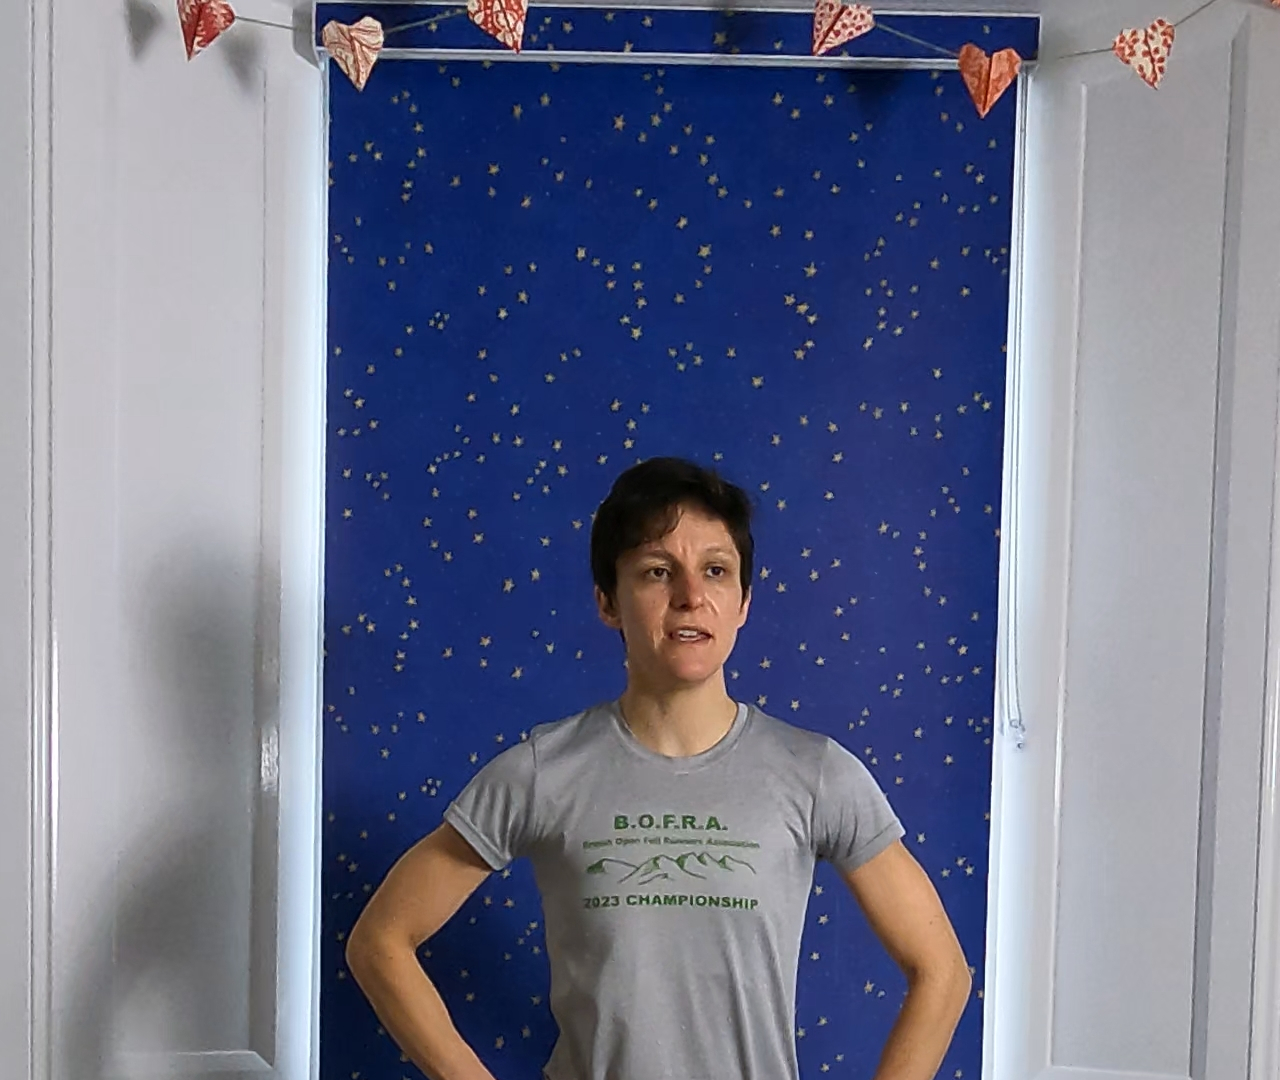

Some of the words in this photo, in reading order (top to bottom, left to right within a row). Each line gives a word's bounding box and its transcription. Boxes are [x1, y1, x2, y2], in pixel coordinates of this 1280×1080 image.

[614, 814, 728, 830] B.O.F.R.A.
[615, 837, 640, 847] Open
[584, 895, 619, 908] 2023
[626, 894, 759, 910] CHAMPIONSHIP
